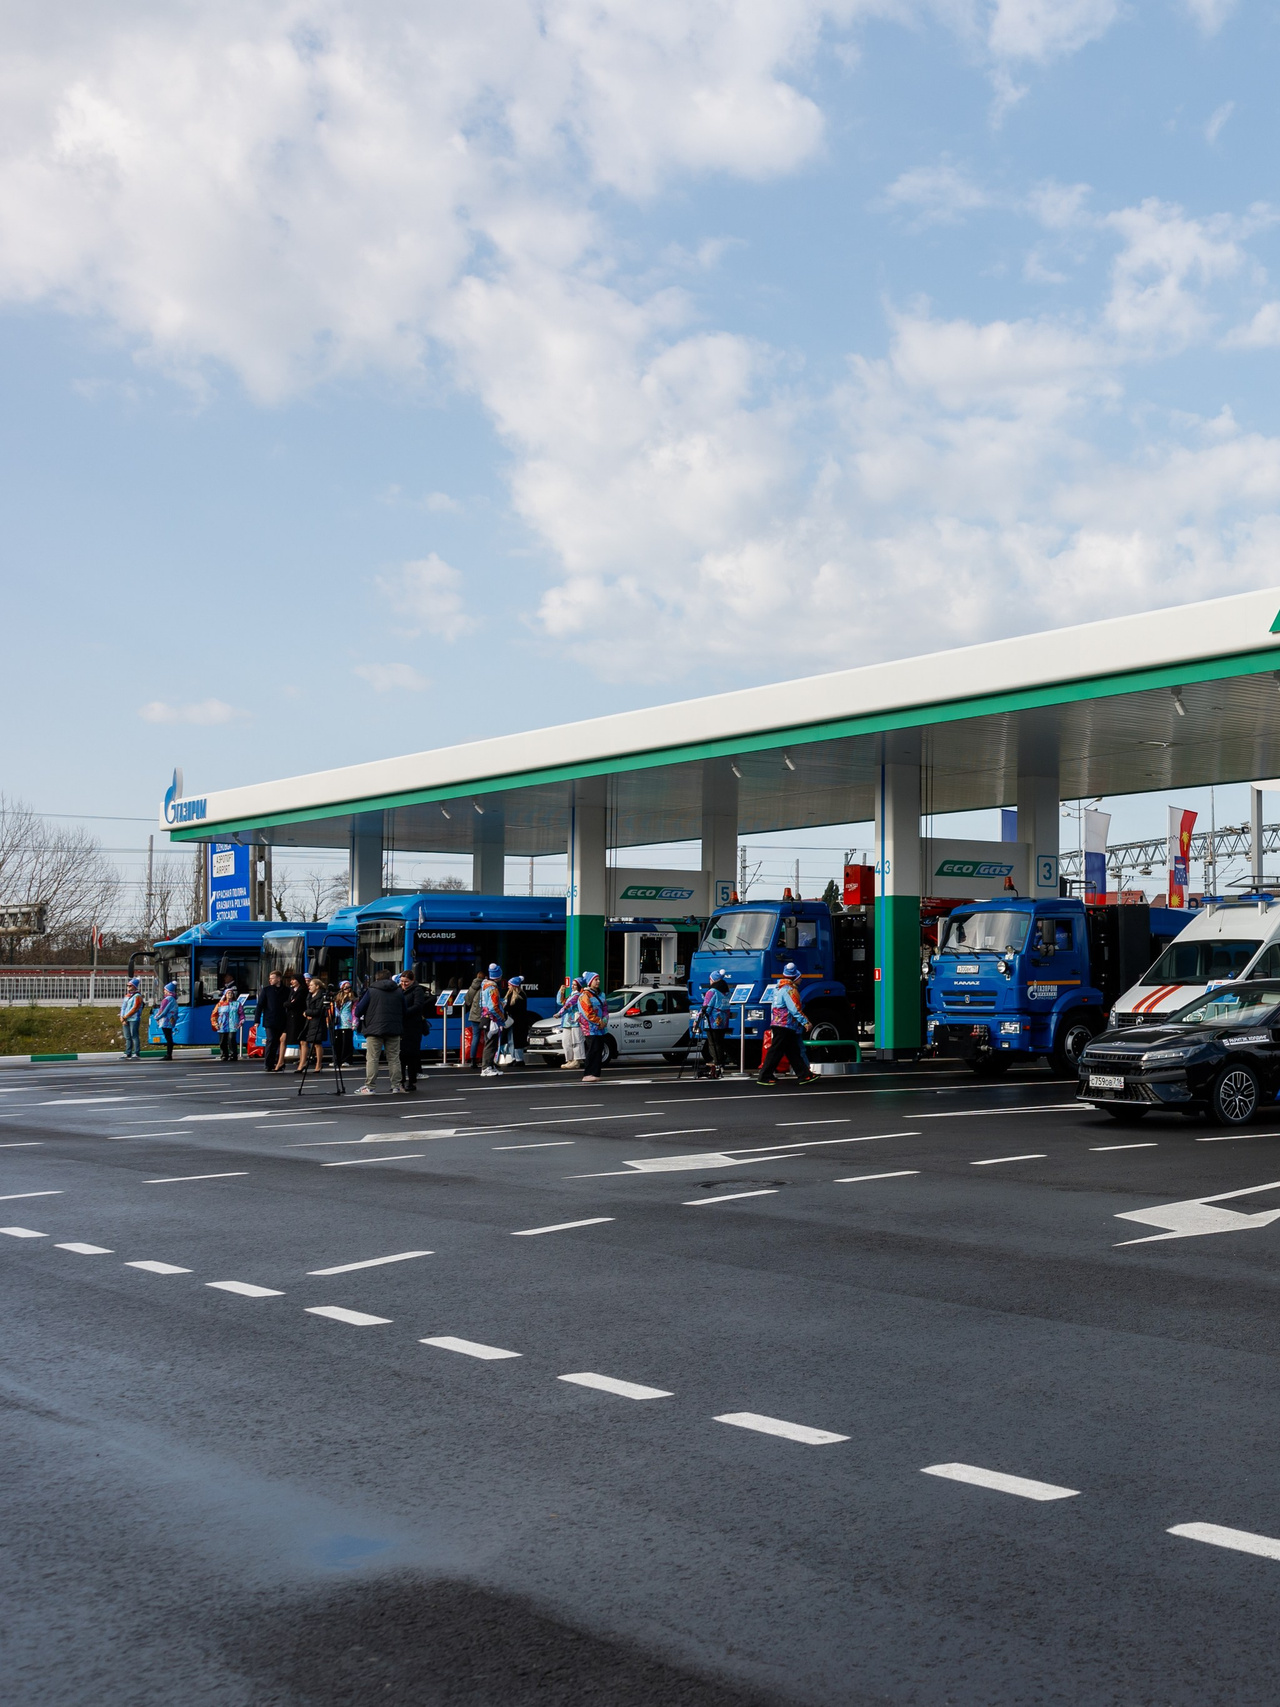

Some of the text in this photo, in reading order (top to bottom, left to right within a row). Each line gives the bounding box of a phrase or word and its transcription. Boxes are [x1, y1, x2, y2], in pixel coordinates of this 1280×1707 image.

[176, 799, 207, 823] ГАЗПРОМ
[885, 860, 891, 875] 3
[943, 865, 973, 873] ECO
[1043, 862, 1052, 880] 3
[721, 886, 730, 901] 5
